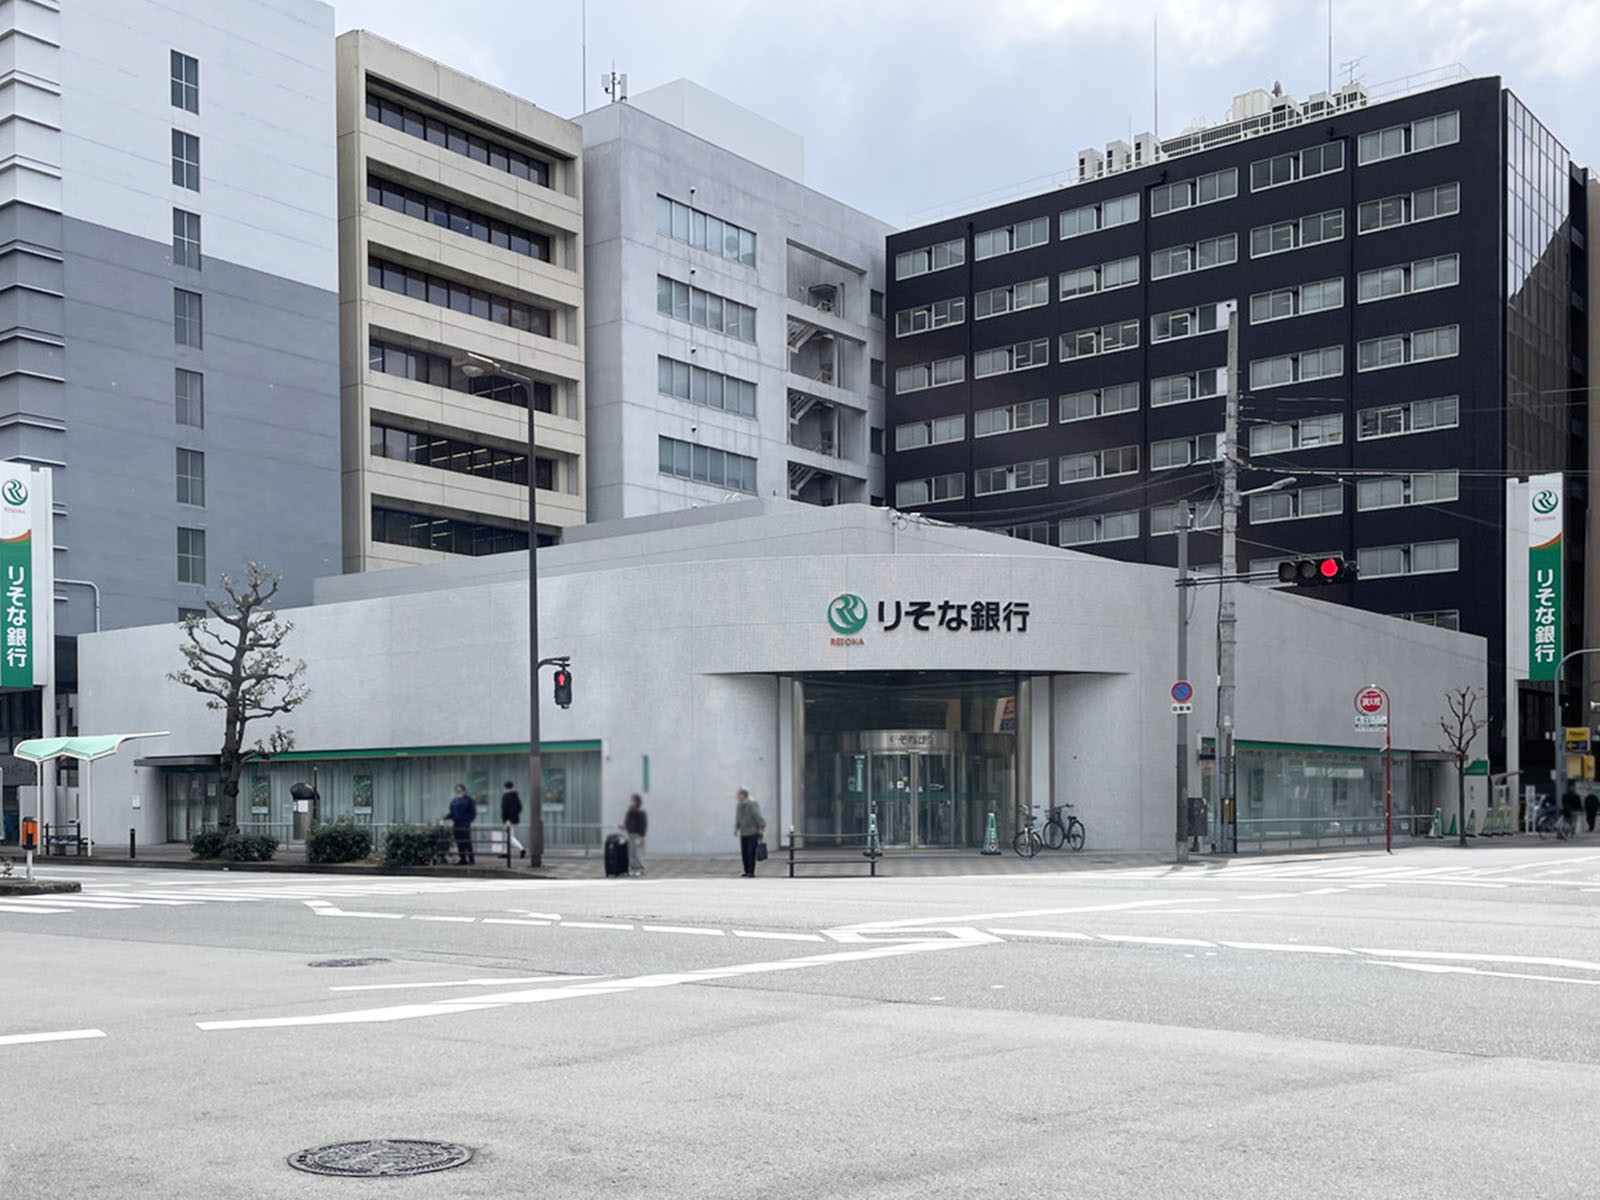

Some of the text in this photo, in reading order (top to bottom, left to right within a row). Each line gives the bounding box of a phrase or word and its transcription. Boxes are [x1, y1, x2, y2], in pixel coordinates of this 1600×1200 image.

[6, 565, 28, 668] りそな銀行
[829, 637, 865, 647] RESONA
[877, 600, 1031, 632] りそな銀行
[1534, 568, 1556, 663] りそな銀行
